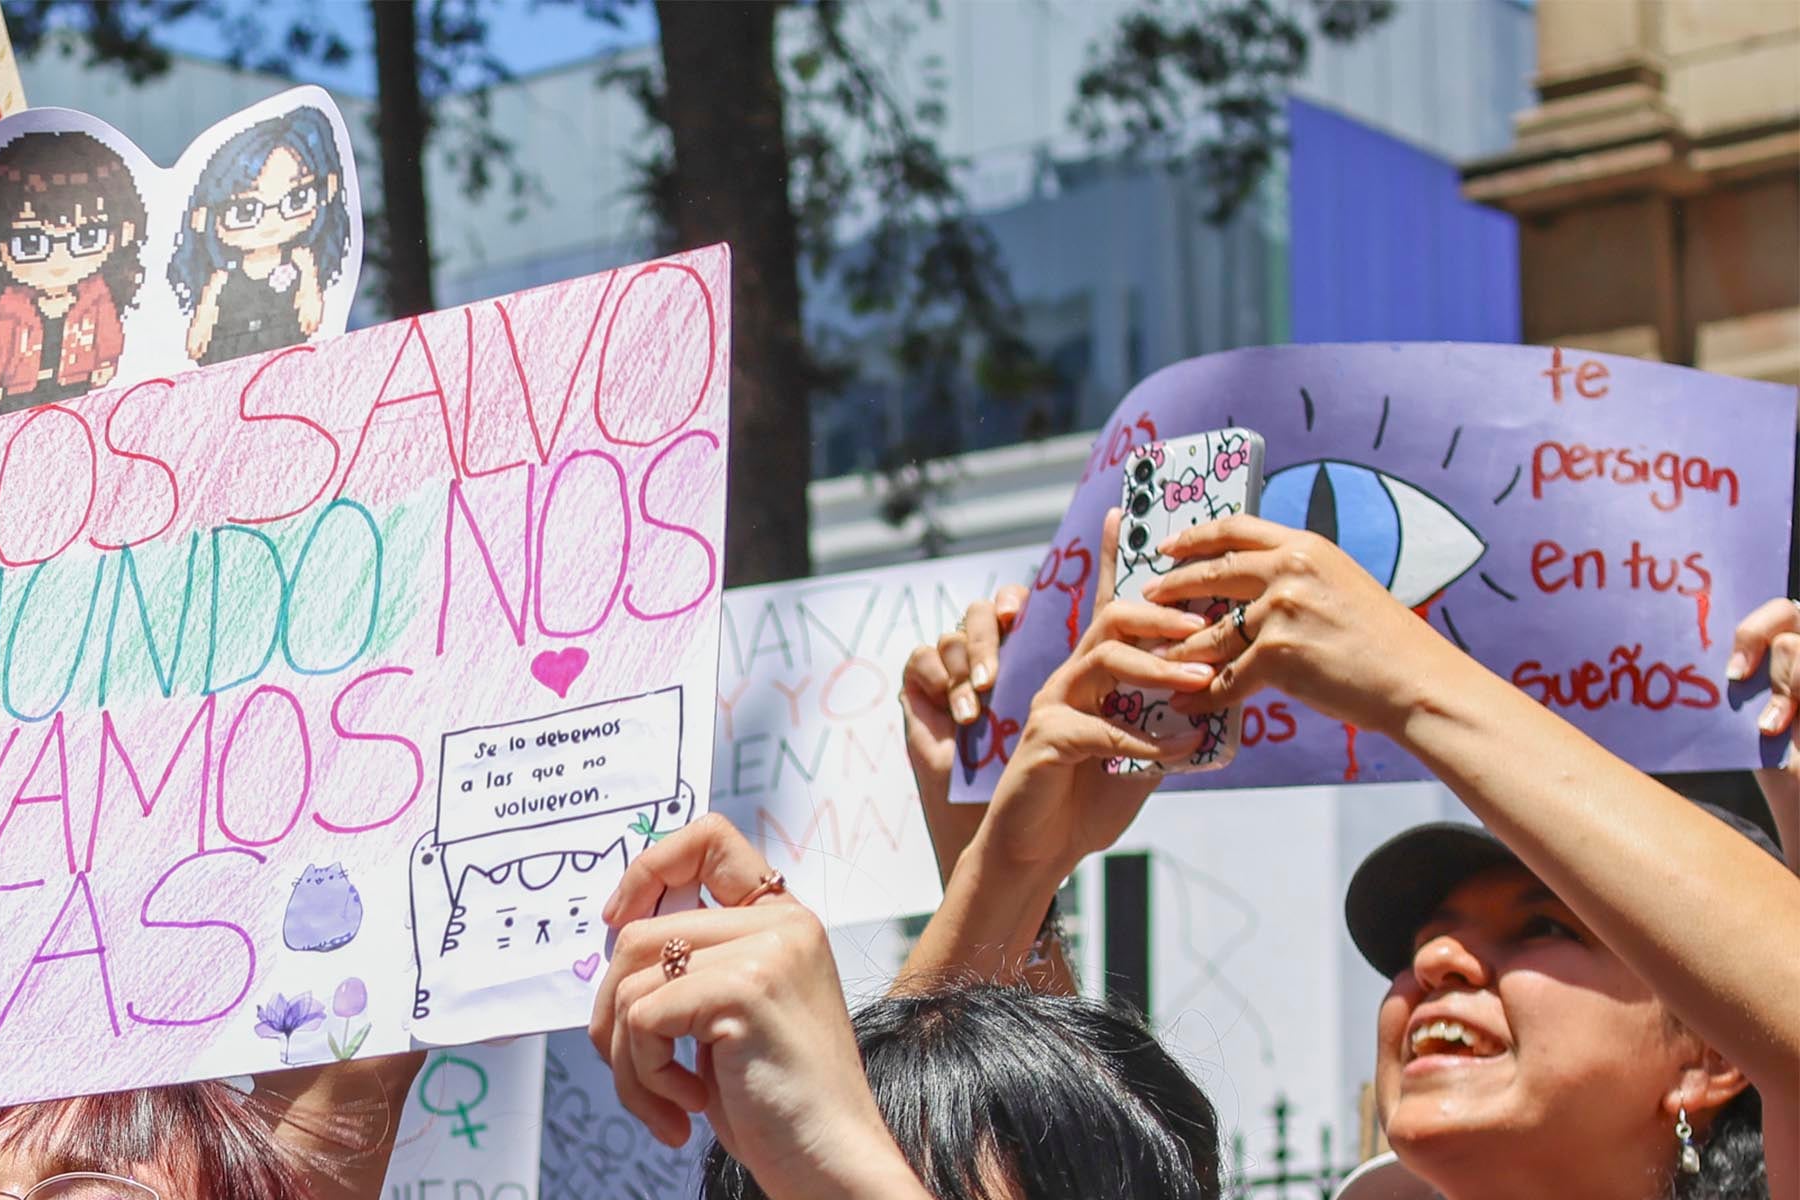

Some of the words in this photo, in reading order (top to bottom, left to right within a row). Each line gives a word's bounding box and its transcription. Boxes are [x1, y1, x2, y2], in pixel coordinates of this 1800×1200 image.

[228, 263, 716, 523] SALVO
[1541, 345, 1612, 405] te
[1532, 440, 1741, 512] persigan
[436, 430, 719, 656] NOS
[1531, 539, 1607, 594] en
[1621, 540, 1713, 598] tus
[1512, 643, 1722, 711] sueños
[474, 740, 498, 759] Se
[509, 735, 526, 752] lo
[535, 718, 622, 748] debemos
[460, 778, 474, 793] a
[486, 771, 514, 789] las
[531, 763, 566, 783] que
[582, 754, 607, 771] no
